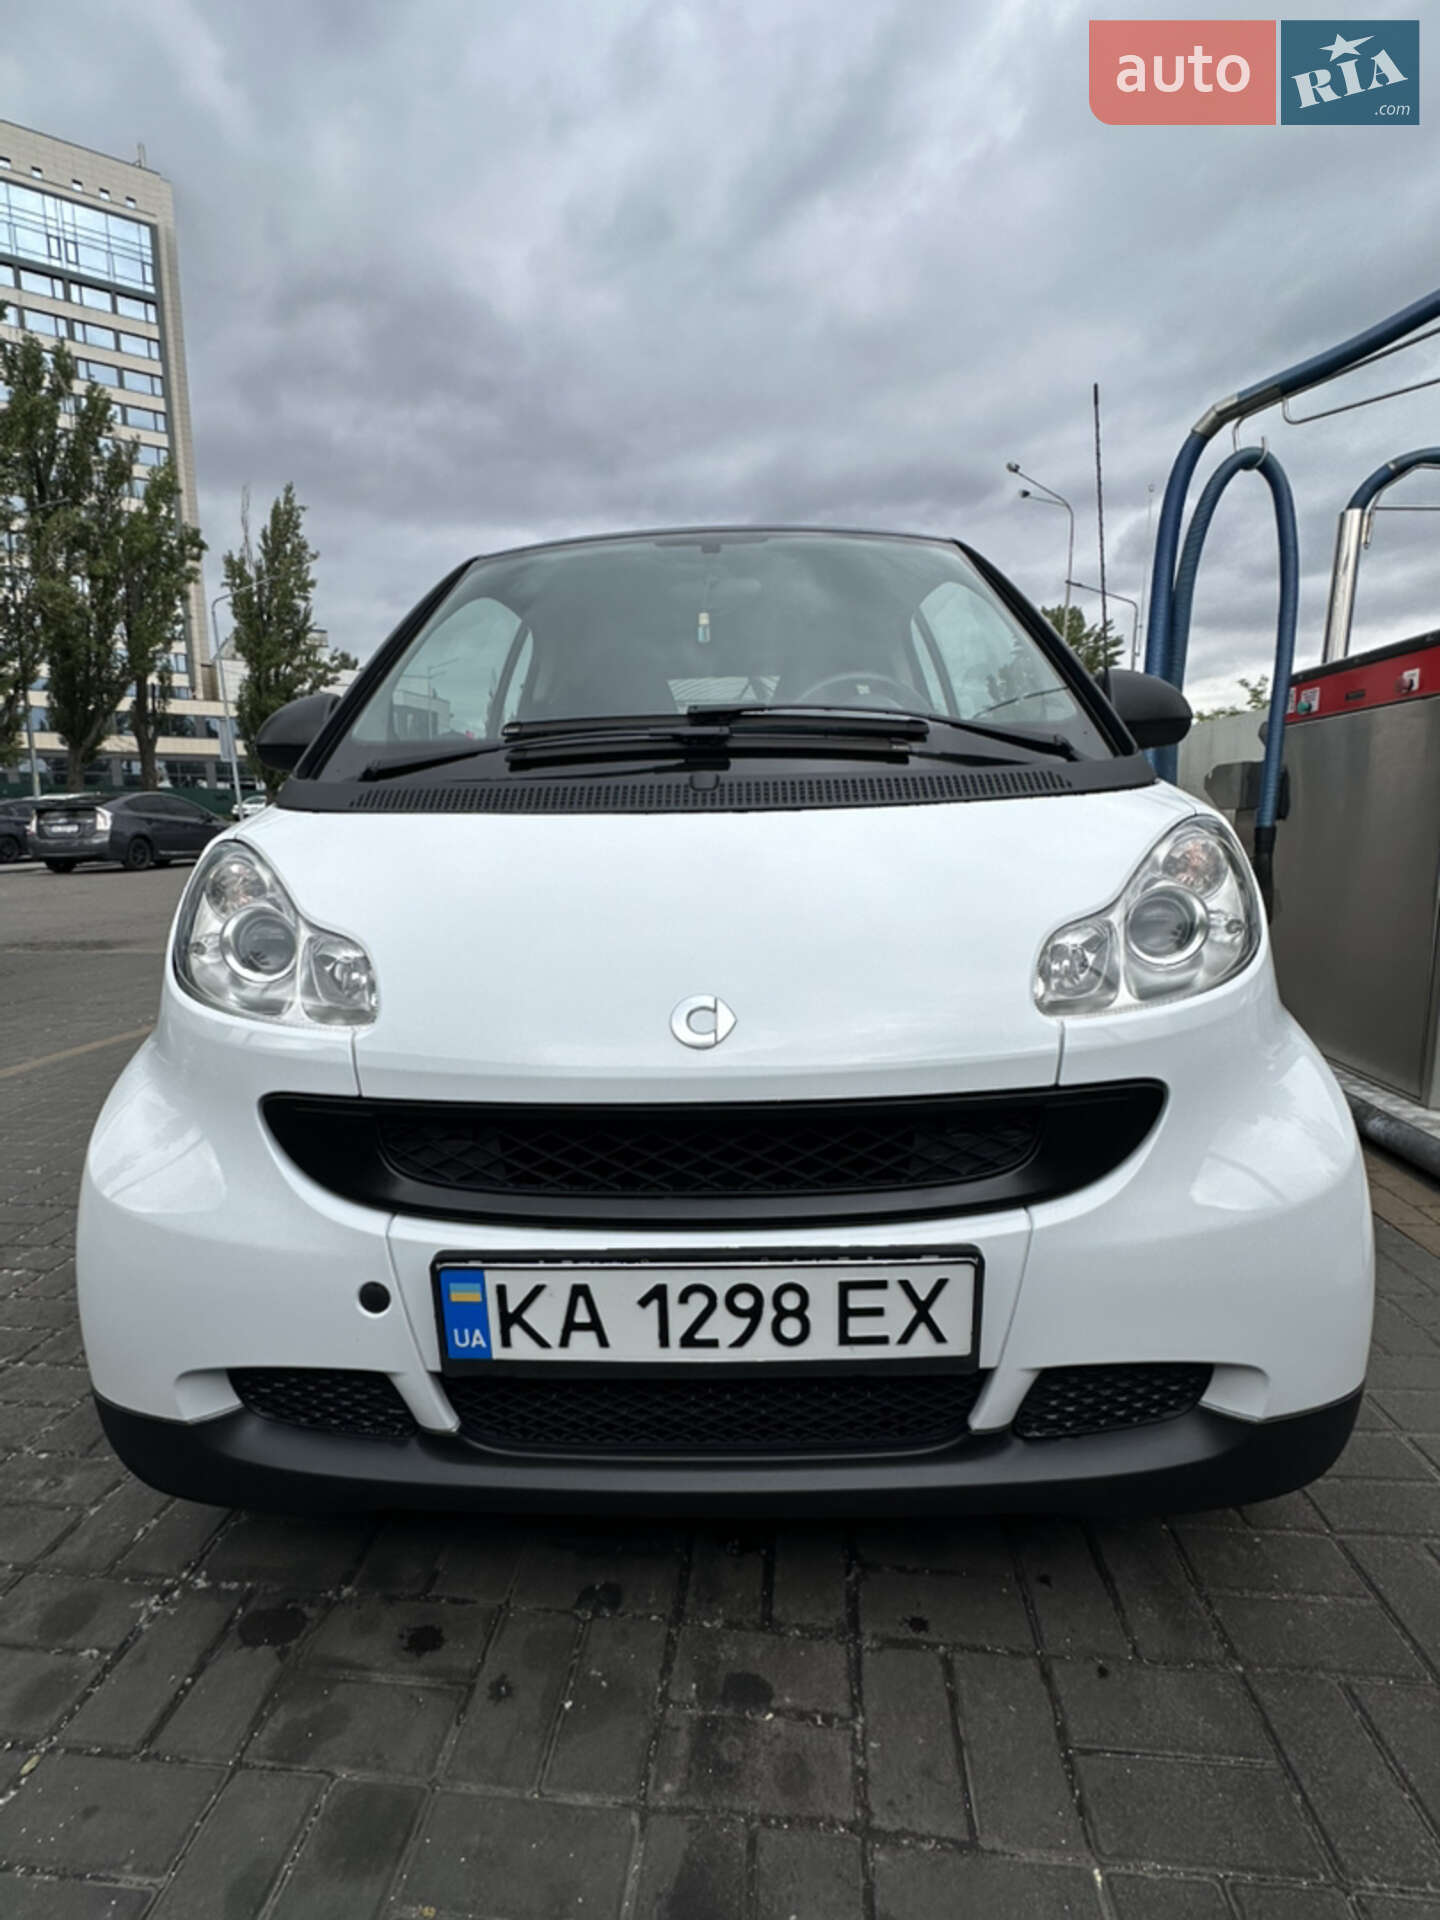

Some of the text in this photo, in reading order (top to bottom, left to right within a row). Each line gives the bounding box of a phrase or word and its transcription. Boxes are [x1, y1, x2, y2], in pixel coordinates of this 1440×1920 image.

[496, 1277, 949, 1349] KA 1298 EX
[453, 1328, 487, 1349] UA
